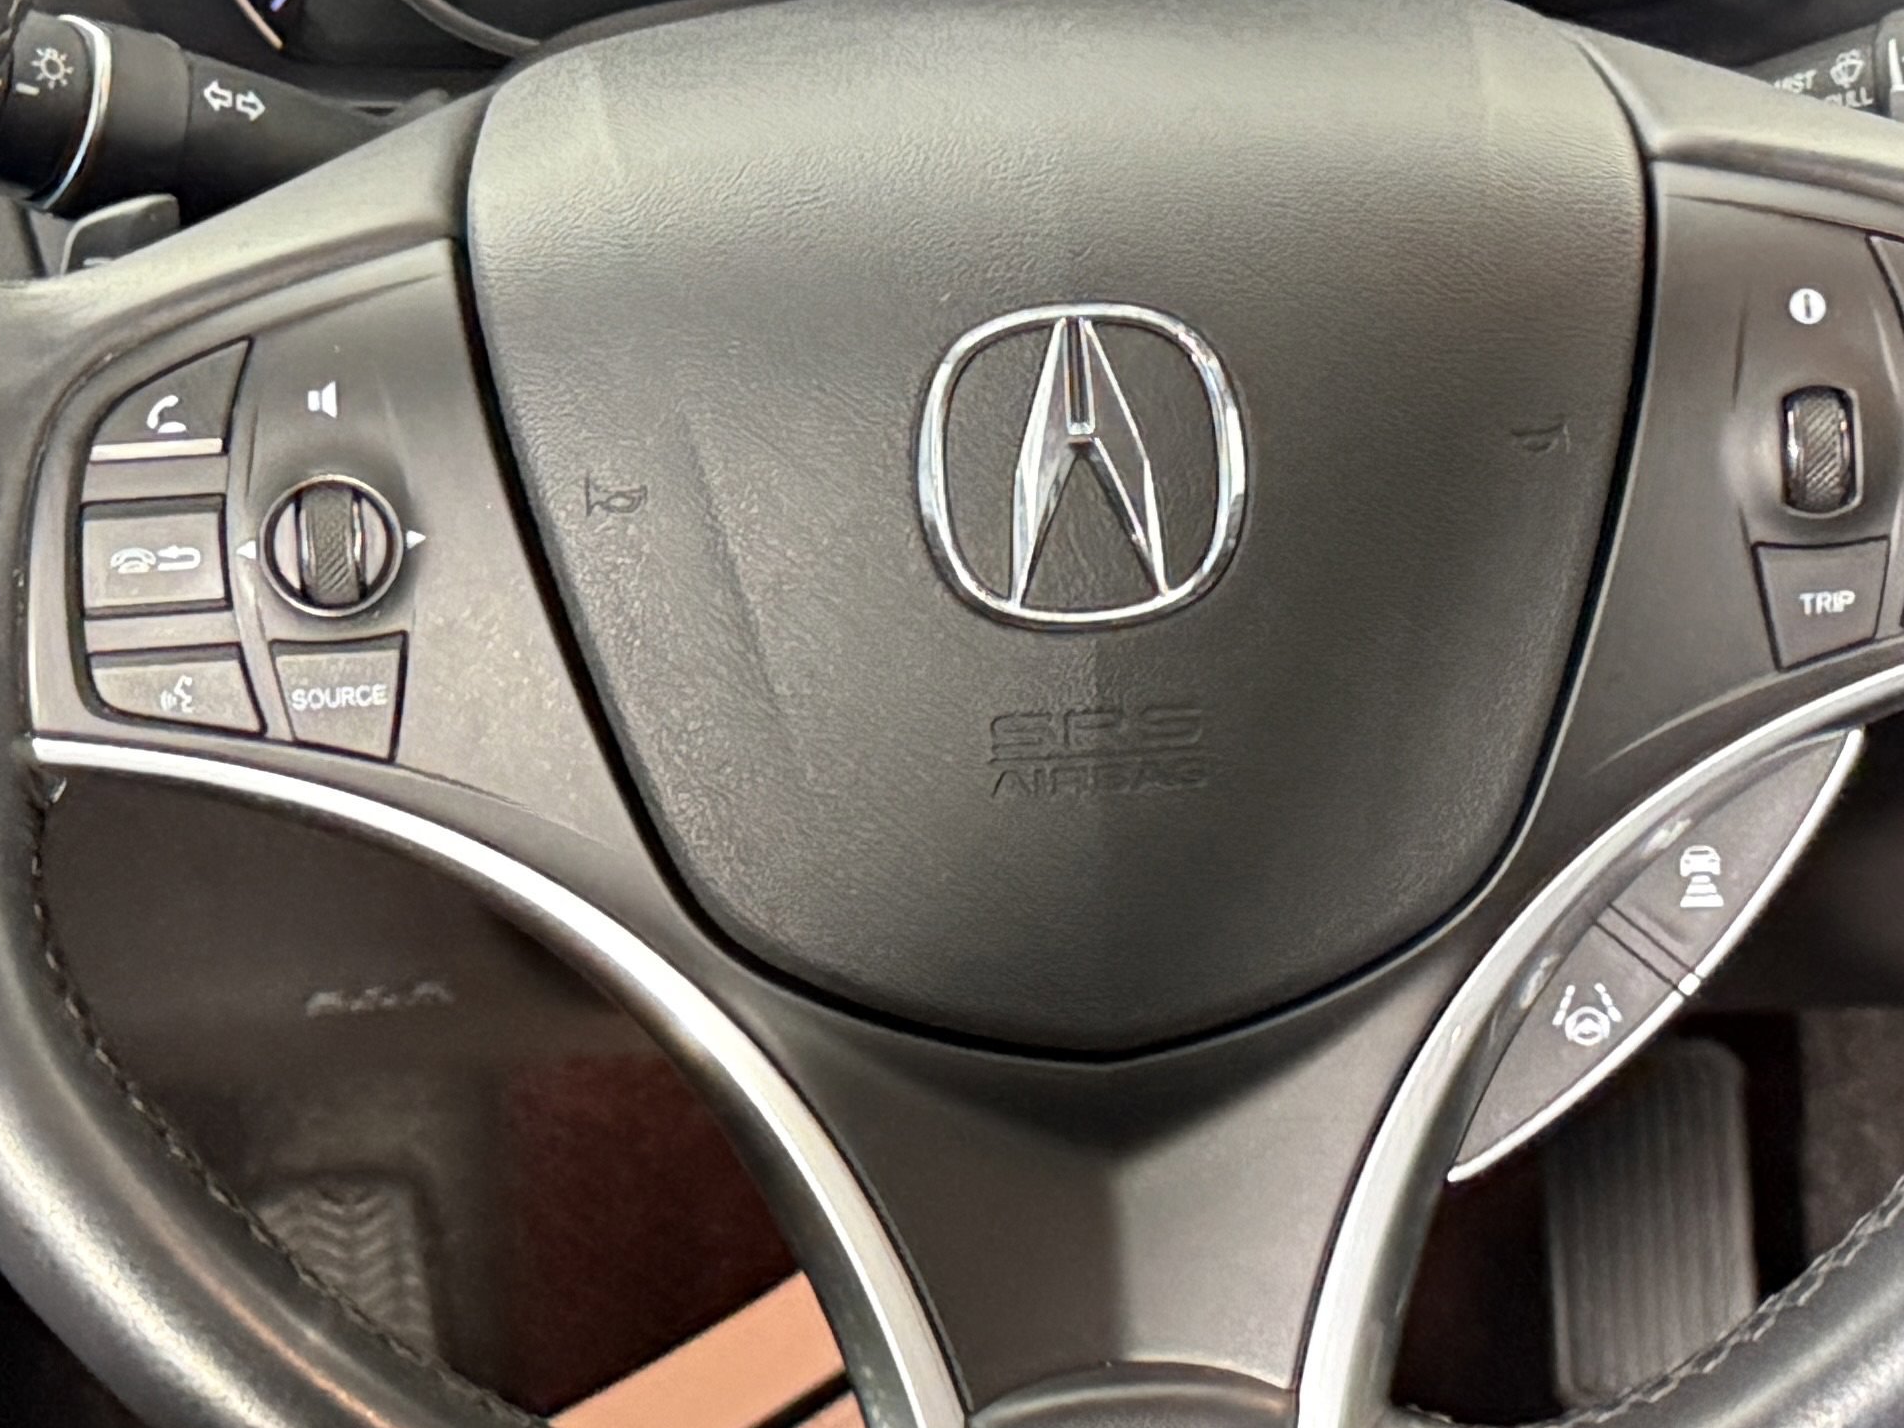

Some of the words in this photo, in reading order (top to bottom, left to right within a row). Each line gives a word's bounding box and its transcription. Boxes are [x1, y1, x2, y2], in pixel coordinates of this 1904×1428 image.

[1800, 590, 1856, 617] TRIP
[291, 682, 388, 711] SOURCE
[989, 706, 1204, 750] SRS
